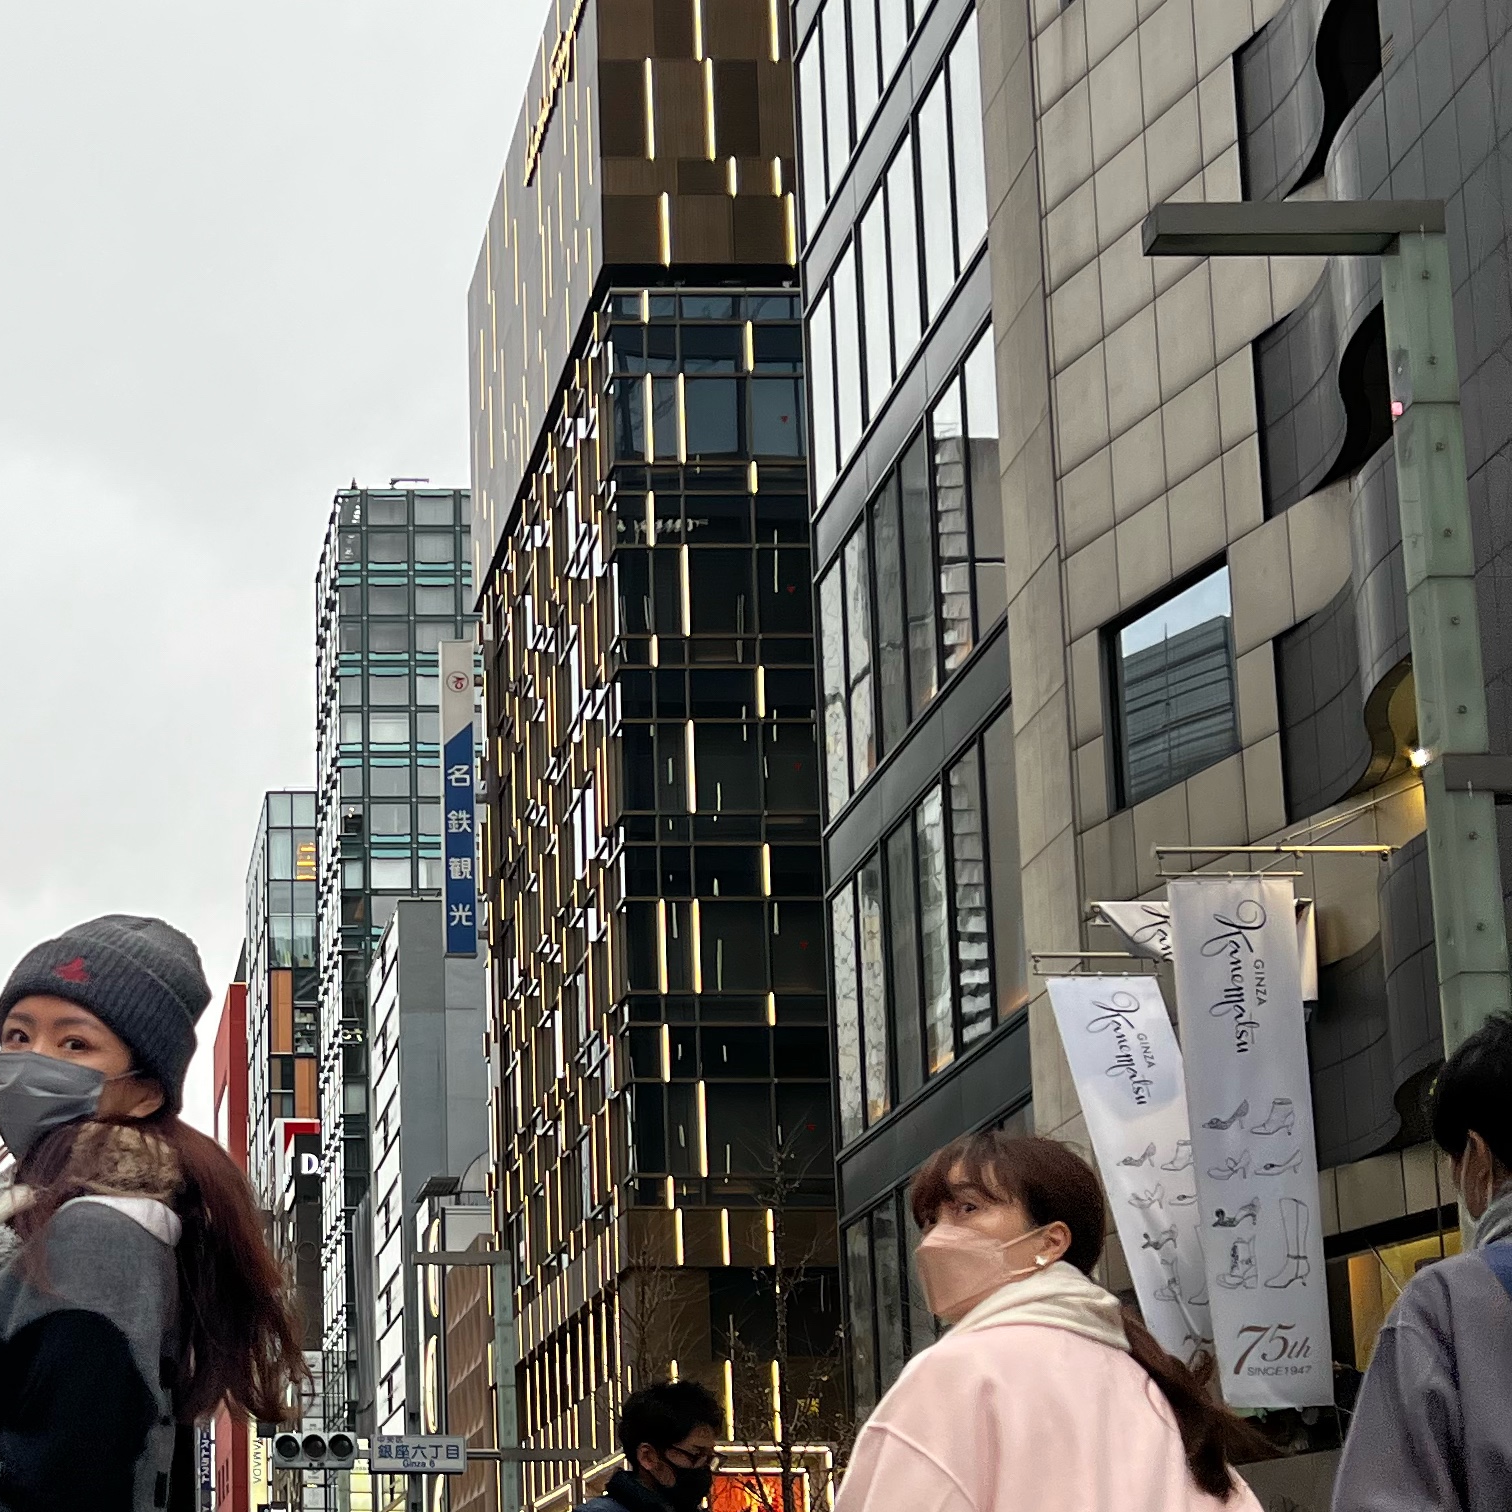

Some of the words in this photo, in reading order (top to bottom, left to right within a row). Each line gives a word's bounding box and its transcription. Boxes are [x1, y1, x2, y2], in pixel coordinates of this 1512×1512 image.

[447, 764, 473, 927] 名鉄観光
[1201, 900, 1267, 1053] Kanematsu
[1254, 959, 1267, 1006] GINZA
[1086, 991, 1153, 1105] Kanematsu
[1137, 1033, 1156, 1068] GINZA
[1233, 1323, 1311, 1375] 75th
[378, 1444, 460, 1459] 銀座六丁目
